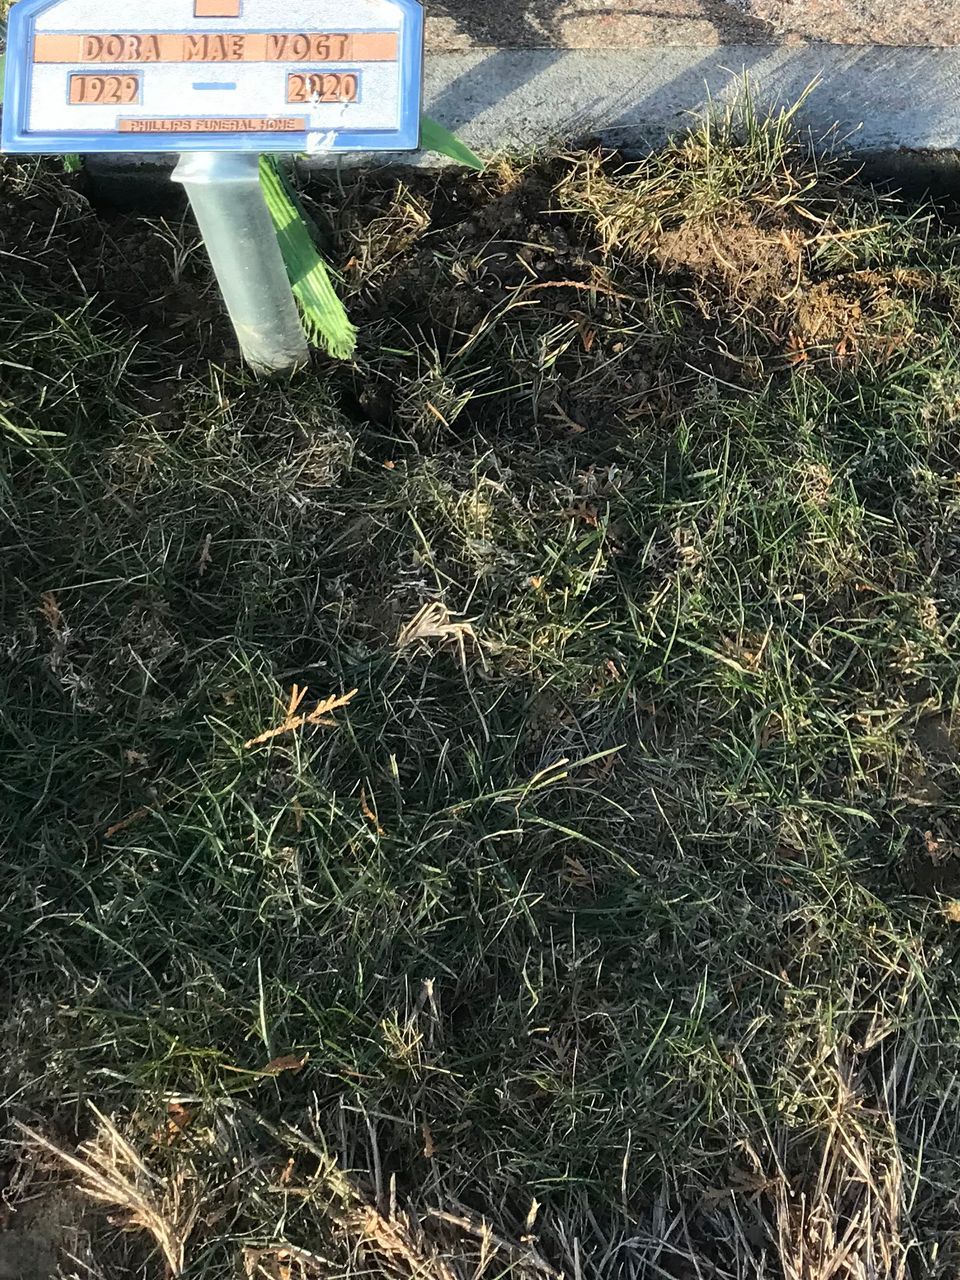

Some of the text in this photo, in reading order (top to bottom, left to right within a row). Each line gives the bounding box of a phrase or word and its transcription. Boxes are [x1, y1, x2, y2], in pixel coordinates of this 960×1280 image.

[85, 33, 348, 61] DORA MAE VOGT
[75, 73, 358, 103] 1929 2020
[130, 118, 296, 132] PHILLIPS FUNERAL HOME
